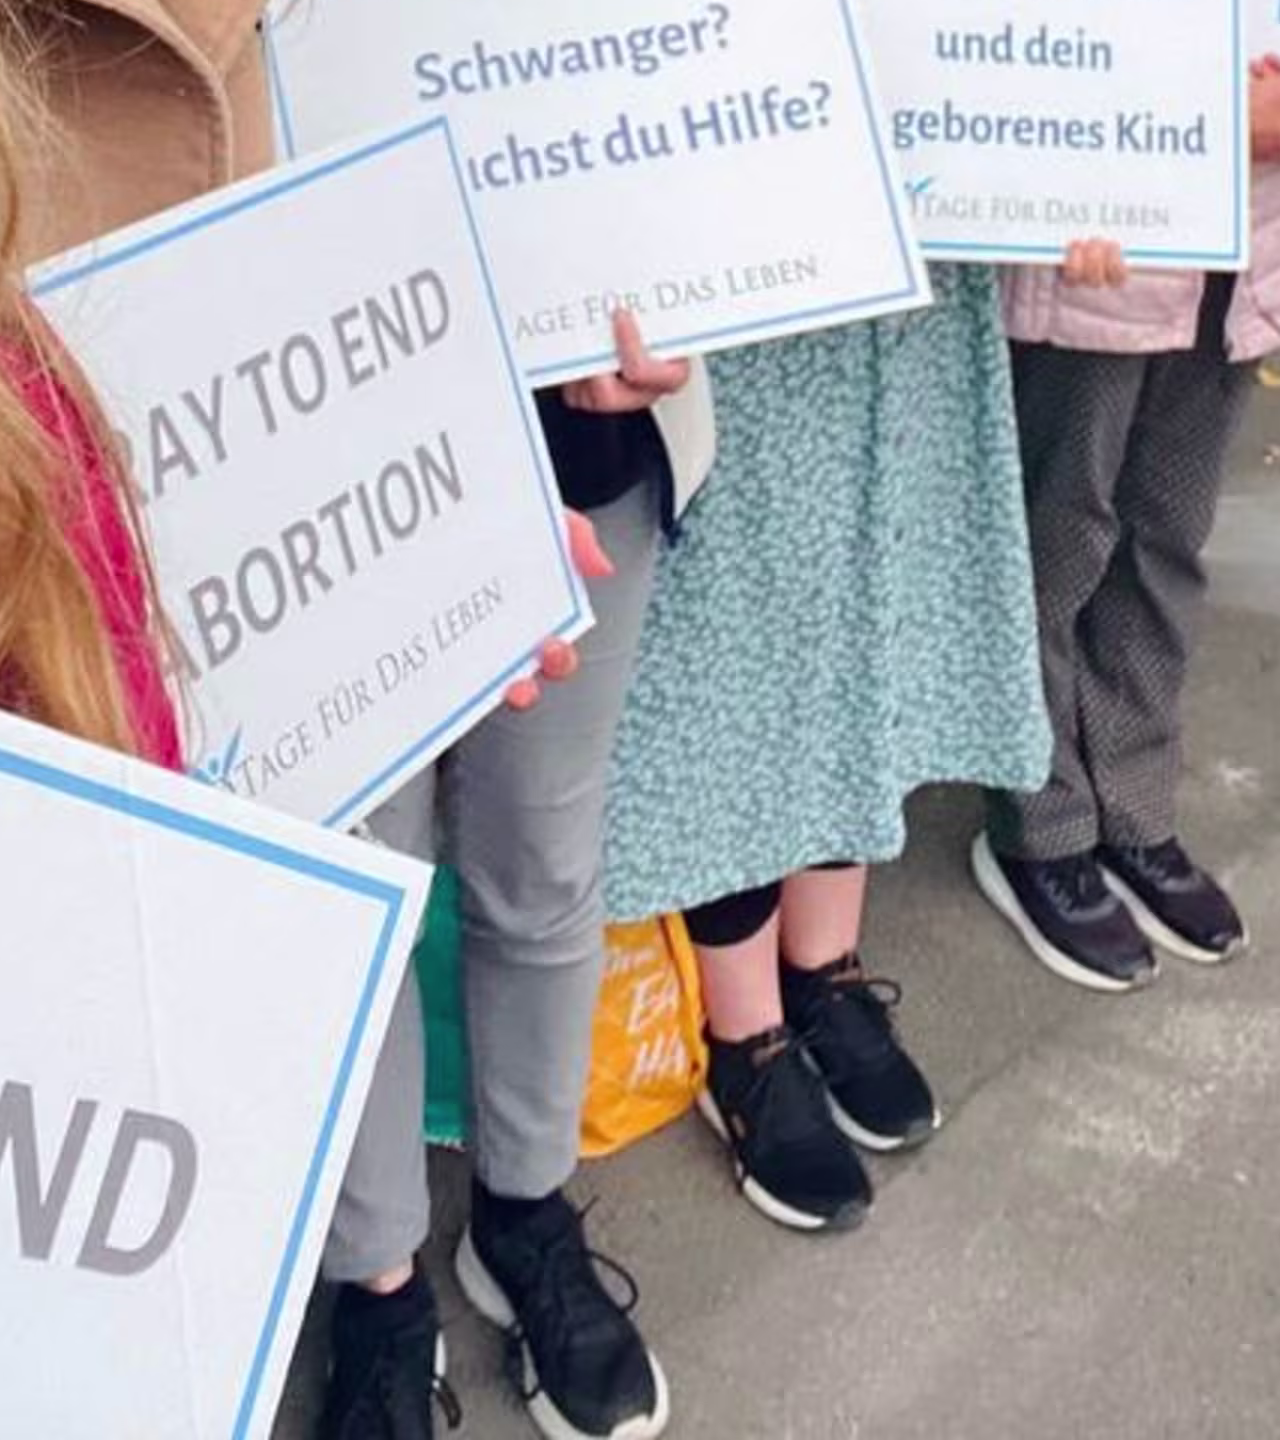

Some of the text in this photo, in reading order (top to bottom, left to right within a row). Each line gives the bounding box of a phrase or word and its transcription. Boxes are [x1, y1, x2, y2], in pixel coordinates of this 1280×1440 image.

[413, 2, 732, 104] Schwanger?
[935, 22, 1113, 72] und dein
[603, 112, 673, 166] du
[681, 80, 833, 153] Hilfe?
[891, 98, 1207, 156] geborenes Kind
[515, 302, 578, 340] AGE
[655, 275, 717, 312] DAS
[724, 254, 820, 296] LEBEN
[143, 267, 451, 500] AY TO END
[375, 637, 428, 694] DAS
[430, 577, 505, 653] LEBEN
